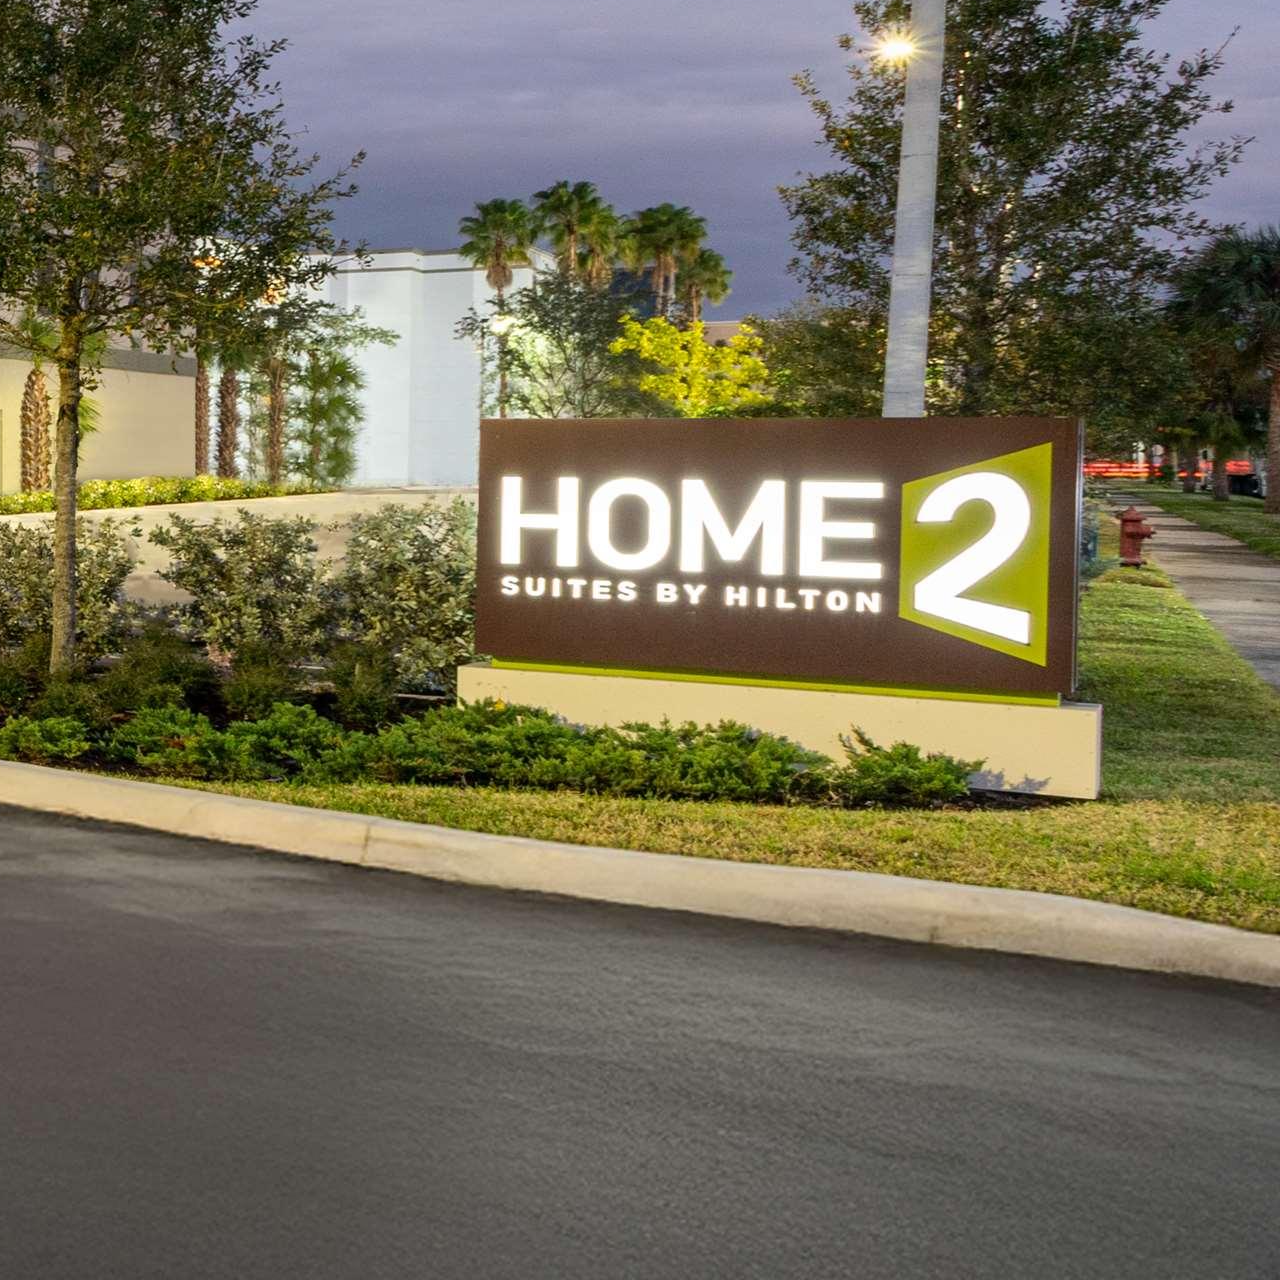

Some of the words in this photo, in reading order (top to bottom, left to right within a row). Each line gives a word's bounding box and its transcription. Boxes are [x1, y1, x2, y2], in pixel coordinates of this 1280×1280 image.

[500, 575, 638, 603] SUITES
[656, 583, 707, 606] BY
[725, 585, 882, 614] HILTON
